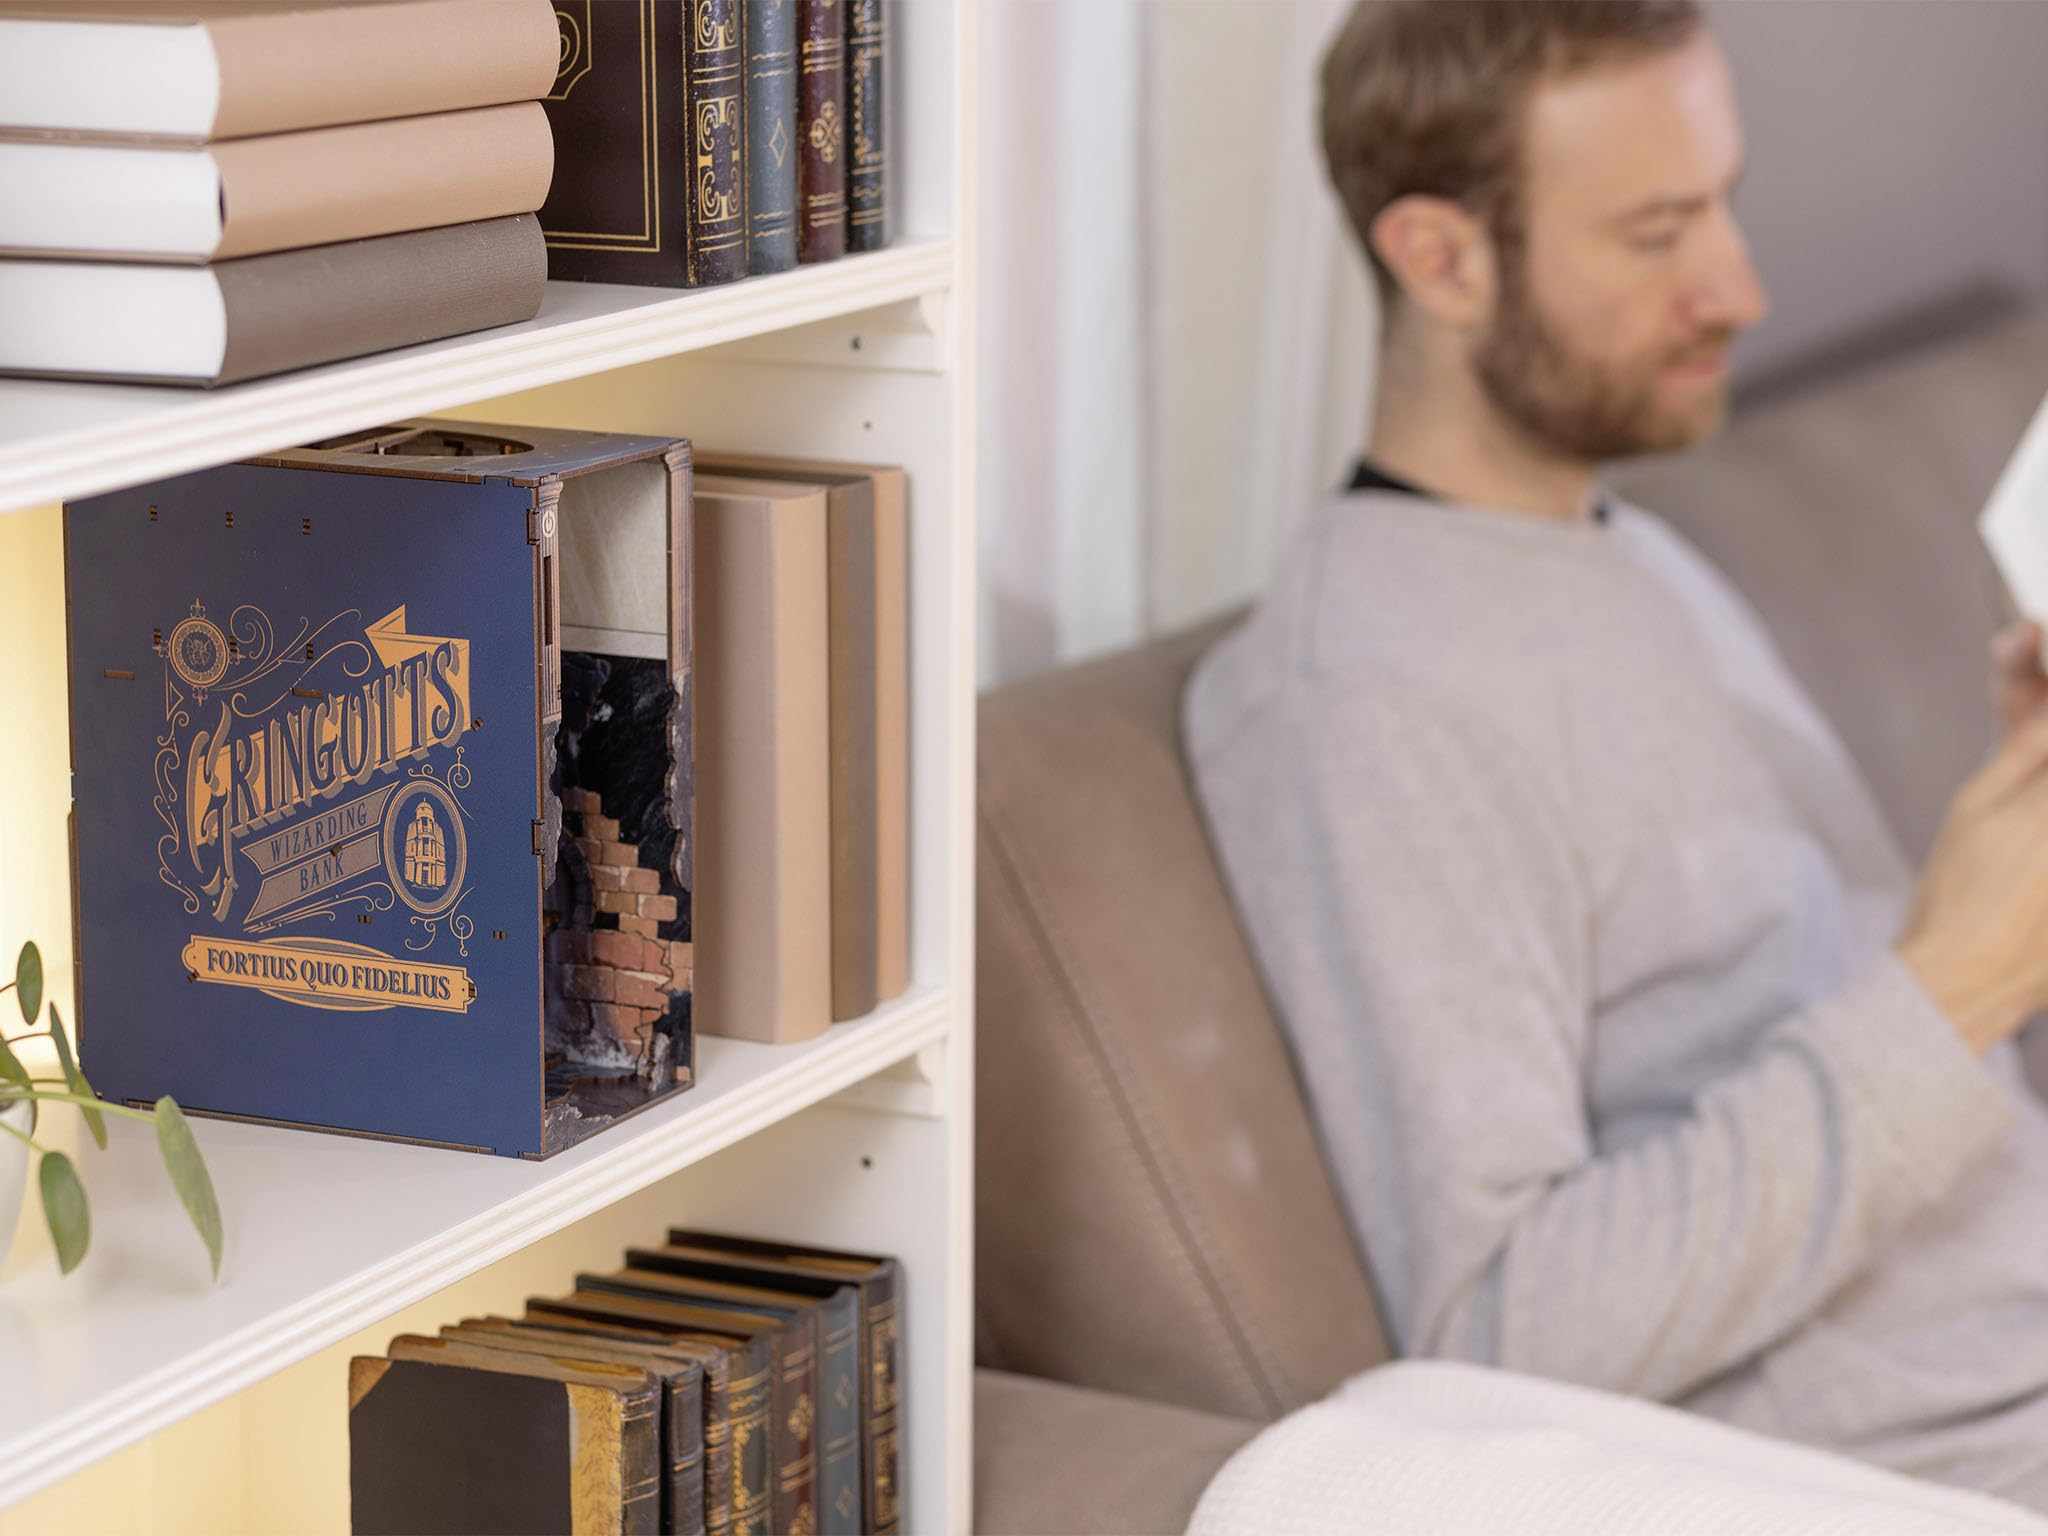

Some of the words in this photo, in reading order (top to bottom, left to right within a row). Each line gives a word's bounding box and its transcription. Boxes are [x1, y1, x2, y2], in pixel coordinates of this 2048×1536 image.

[186, 640, 464, 922] GRINGOTTS
[270, 802, 368, 863] WIZARDING
[299, 852, 345, 892] BANK
[207, 947, 298, 982] FORTIUS
[300, 960, 349, 992] QUO
[351, 964, 452, 1000] FIDELIUS
